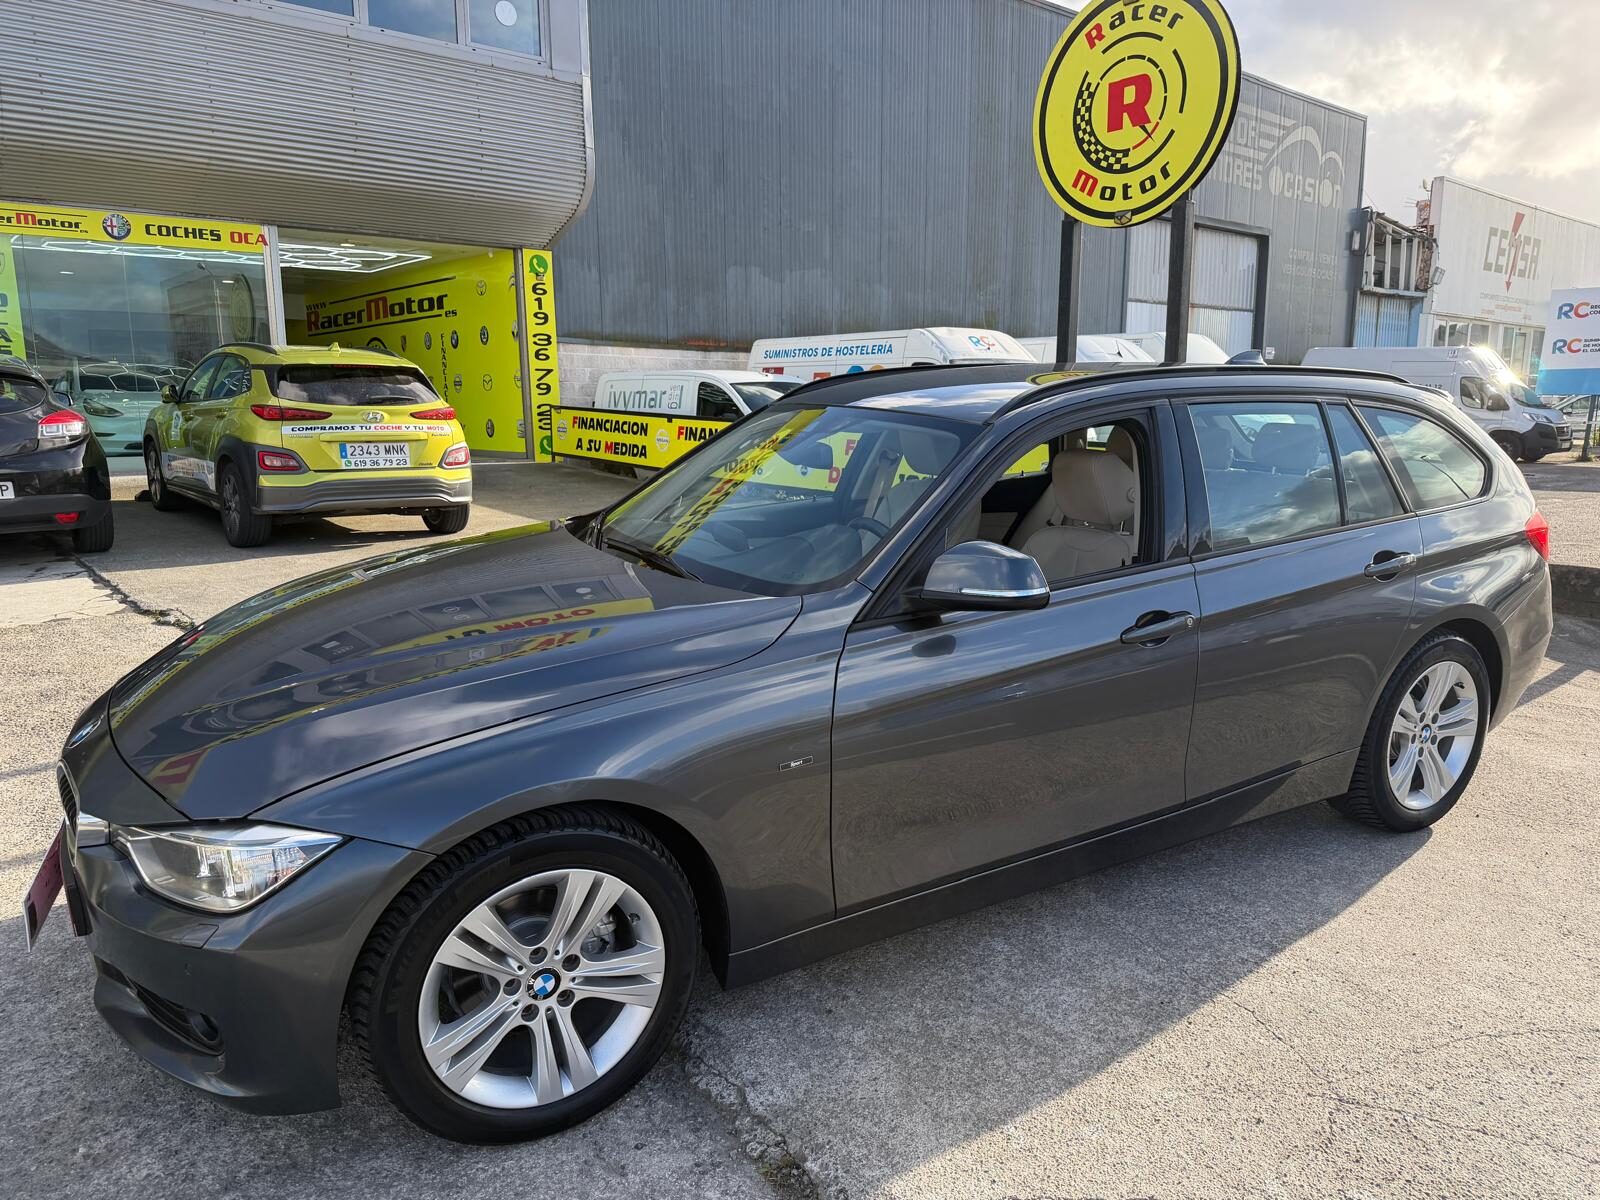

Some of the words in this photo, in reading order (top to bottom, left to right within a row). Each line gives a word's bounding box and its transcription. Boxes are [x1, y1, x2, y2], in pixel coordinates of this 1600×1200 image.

[1084, 4, 1184, 49] Racer
[1107, 73, 1152, 133] R
[1071, 161, 1171, 201] Motor
[145, 223, 222, 242] COCHES
[229, 231, 268, 246] OCA
[306, 293, 448, 332] RacerMotor
[445, 309, 457, 318] es
[532, 282, 549, 326] 619
[1557, 302, 1590, 319] RC
[532, 333, 552, 361] 36
[763, 347, 819, 359] SUMINISTROS
[821, 347, 833, 356] DE
[835, 342, 893, 356] HOSTELERÍA
[1552, 338, 1582, 354] RC
[534, 368, 554, 396] 79
[608, 384, 667, 411] ivymar
[572, 416, 648, 436] FINANCIACION
[350, 445, 380, 457] 2343
[384, 444, 406, 456] MNK
[576, 438, 583, 451] A
[587, 439, 601, 451] SU
[604, 441, 647, 459] MEDIDA
[354, 459, 366, 467] 619
[396, 458, 408, 466] 23
